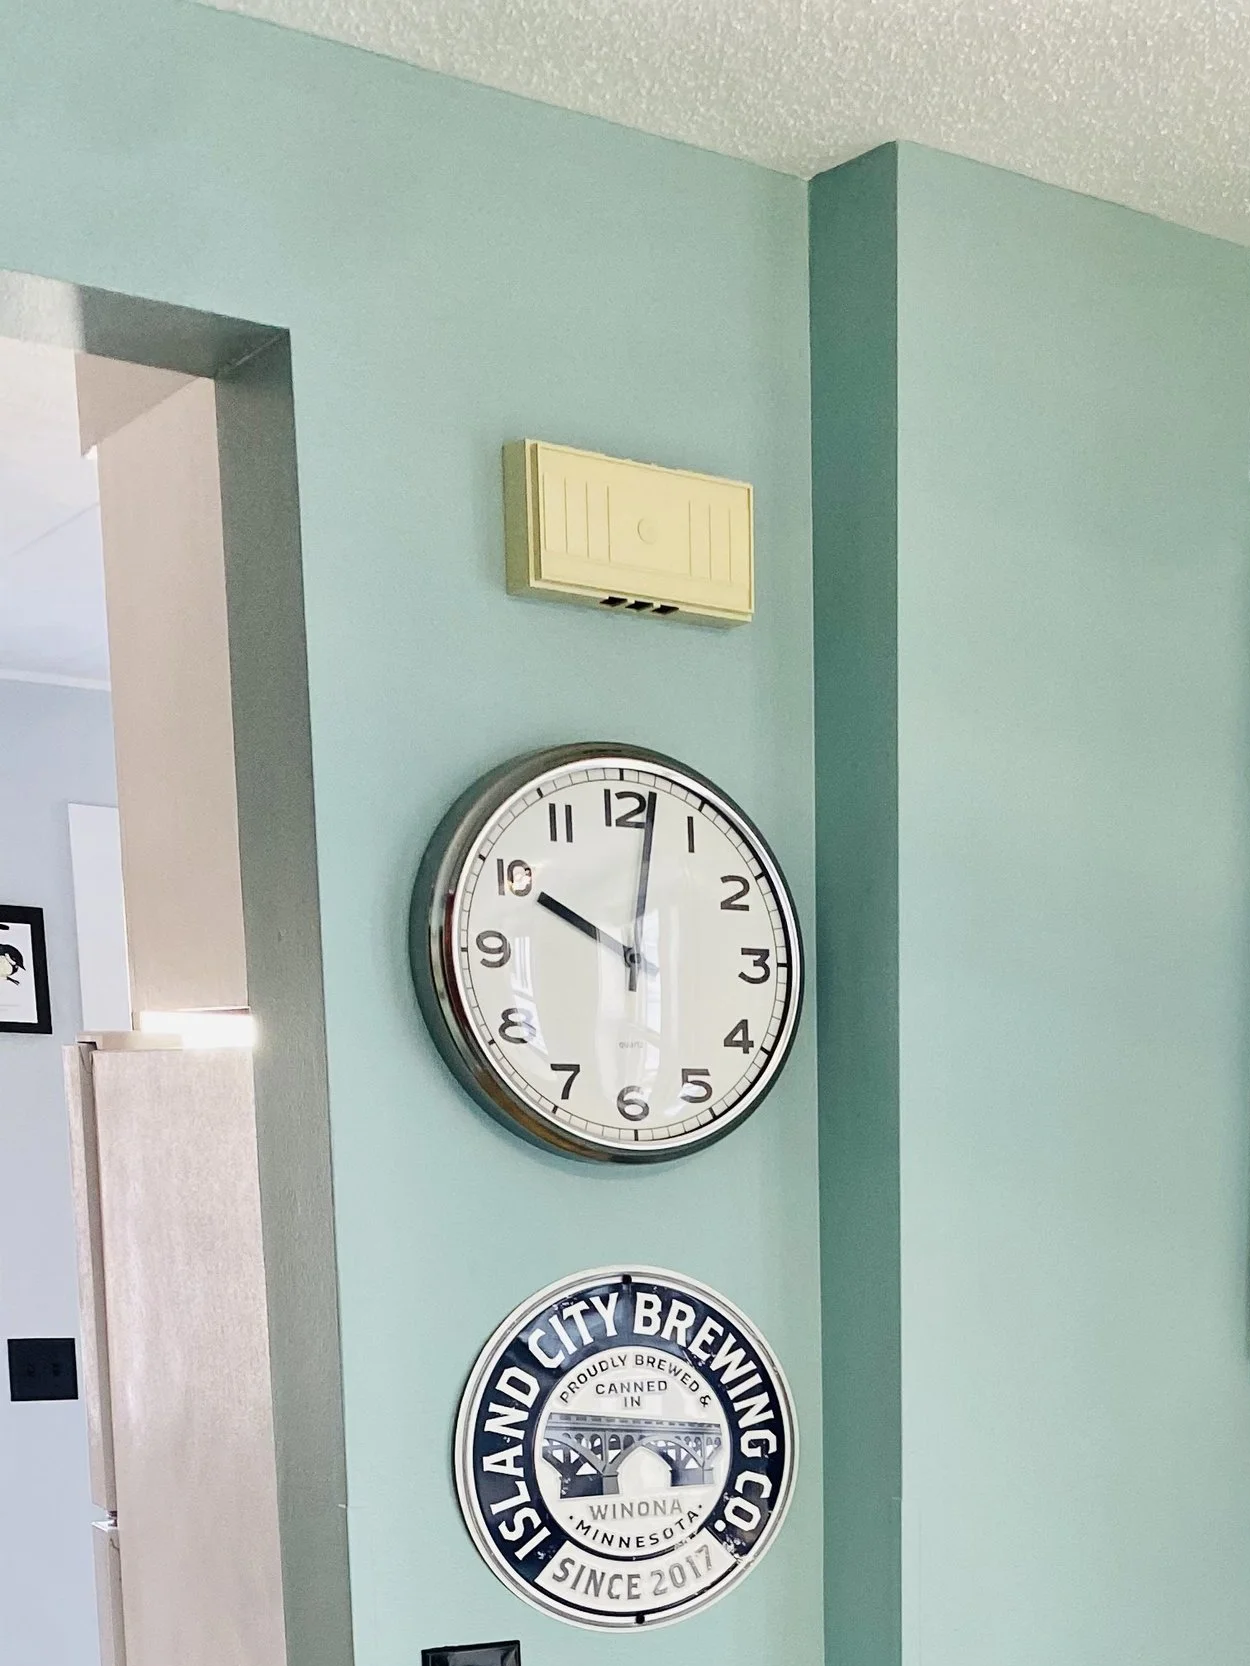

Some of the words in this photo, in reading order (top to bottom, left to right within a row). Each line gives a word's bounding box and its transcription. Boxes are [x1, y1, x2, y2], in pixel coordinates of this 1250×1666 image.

[548, 803, 573, 843] 11
[603, 788, 647, 829] 12
[686, 816, 695, 854] 1
[496, 858, 532, 897] 10
[720, 875, 750, 911] 2
[475, 930, 511, 968] 9
[738, 948, 770, 984] 3
[498, 1008, 536, 1044] 8
[723, 1019, 754, 1054] 4
[550, 1064, 581, 1100] 7
[680, 1068, 713, 1104] 5
[616, 1085, 650, 1121] 6
[560, 1354, 628, 1404] PROUDLY
[634, 1354, 700, 1393] BREWED
[699, 1394, 712, 1408] &
[595, 1380, 668, 1396] CANNED
[623, 1396, 642, 1408] IN
[483, 1366, 551, 1561] ISLAND
[528, 1292, 619, 1369] CITY
[633, 1291, 777, 1459] BREWING
[589, 1498, 683, 1521] WINONA
[575, 1511, 699, 1549] MINNESOTA
[552, 1556, 642, 1600] SINCE
[650, 1544, 715, 1597] 2017
